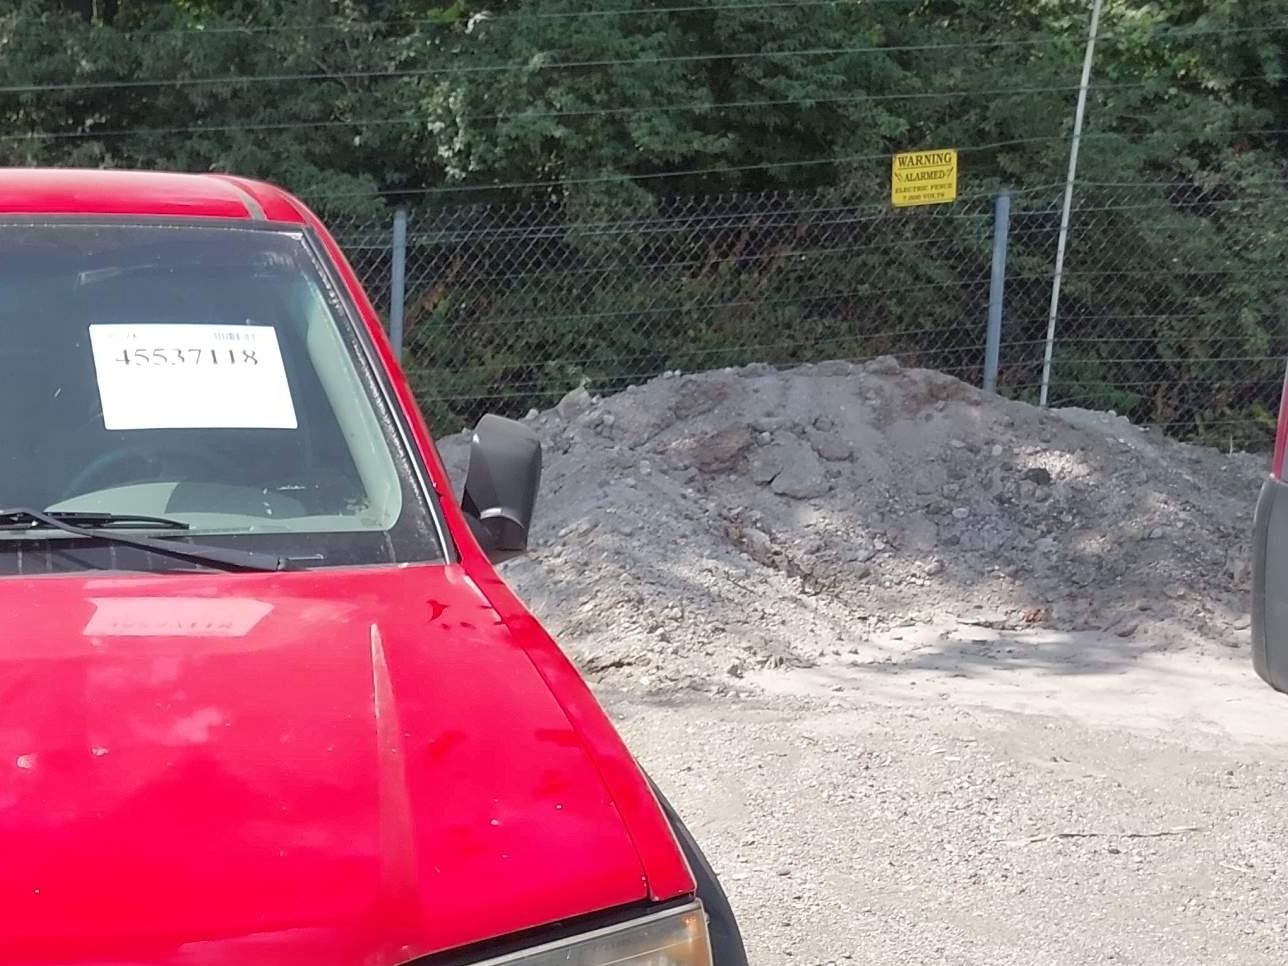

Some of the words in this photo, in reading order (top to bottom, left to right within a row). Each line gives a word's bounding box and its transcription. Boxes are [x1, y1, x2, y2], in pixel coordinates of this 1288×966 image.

[897, 152, 953, 167] WARNING
[904, 170, 946, 182] ALARMED
[115, 348, 259, 366] 45537118
